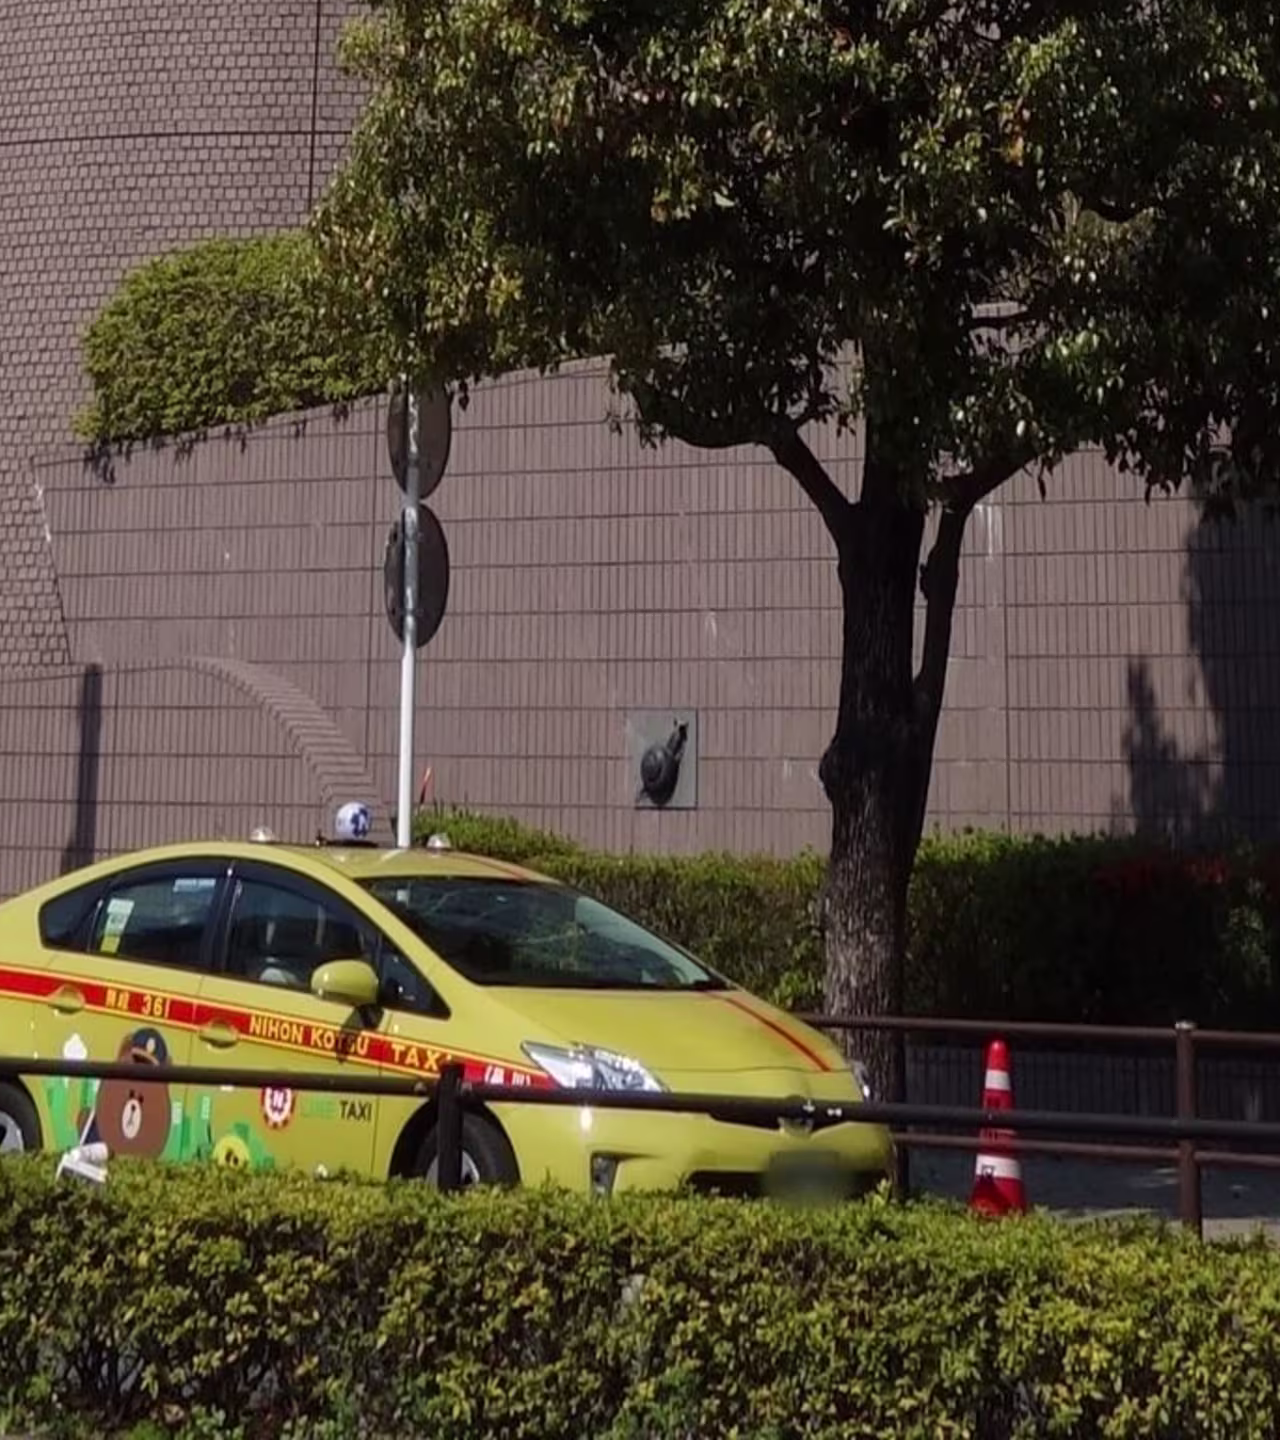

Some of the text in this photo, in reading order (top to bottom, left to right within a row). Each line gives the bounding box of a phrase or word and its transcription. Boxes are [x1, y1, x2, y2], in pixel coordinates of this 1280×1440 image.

[141, 993, 172, 1020] 361
[248, 1014, 453, 1071] NIHON KOTSU TAX
[339, 1099, 373, 1121] TAXI
